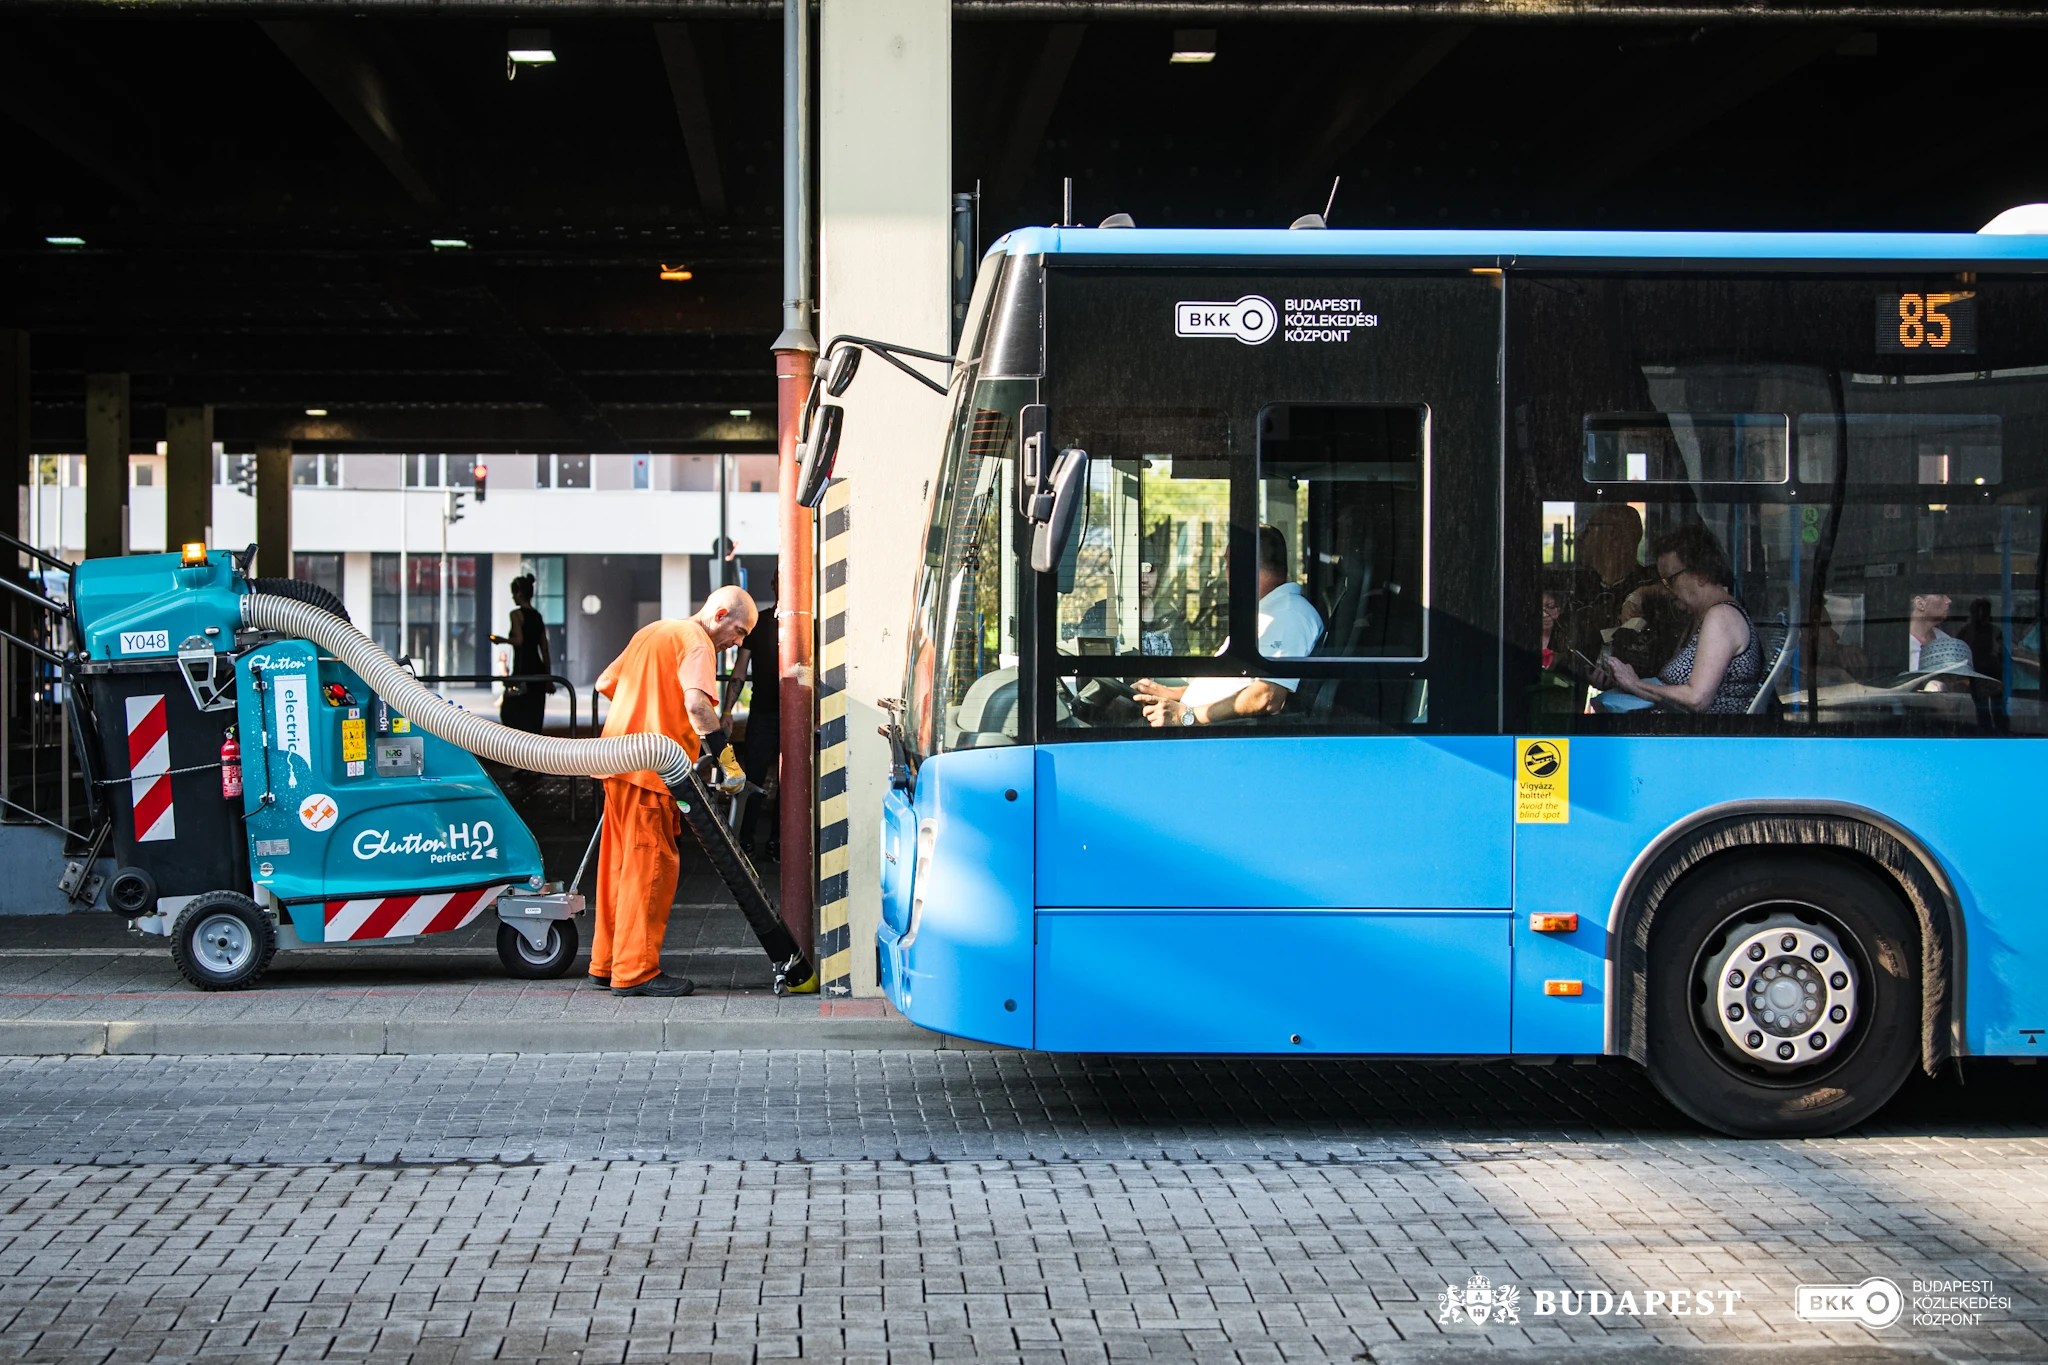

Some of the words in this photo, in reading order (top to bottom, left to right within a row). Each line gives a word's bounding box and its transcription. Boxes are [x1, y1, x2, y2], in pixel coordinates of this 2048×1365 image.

[1284, 299, 1361, 311] BUDAPESTI
[1189, 313, 1231, 326] BKK
[1284, 312, 1378, 326] KÖZLEKEDÉSI
[1899, 293, 1951, 348] 85
[1284, 328, 1350, 342] KÖZPONT
[123, 633, 167, 650] Y048
[284, 689, 300, 751] electric
[1520, 782, 1555, 791] Vigyázz,
[1519, 802, 1543, 810] Avoid
[1545, 802, 1558, 810] the
[1519, 811, 1540, 819] blind
[1542, 811, 1560, 820] spot
[352, 829, 447, 860] Glutton
